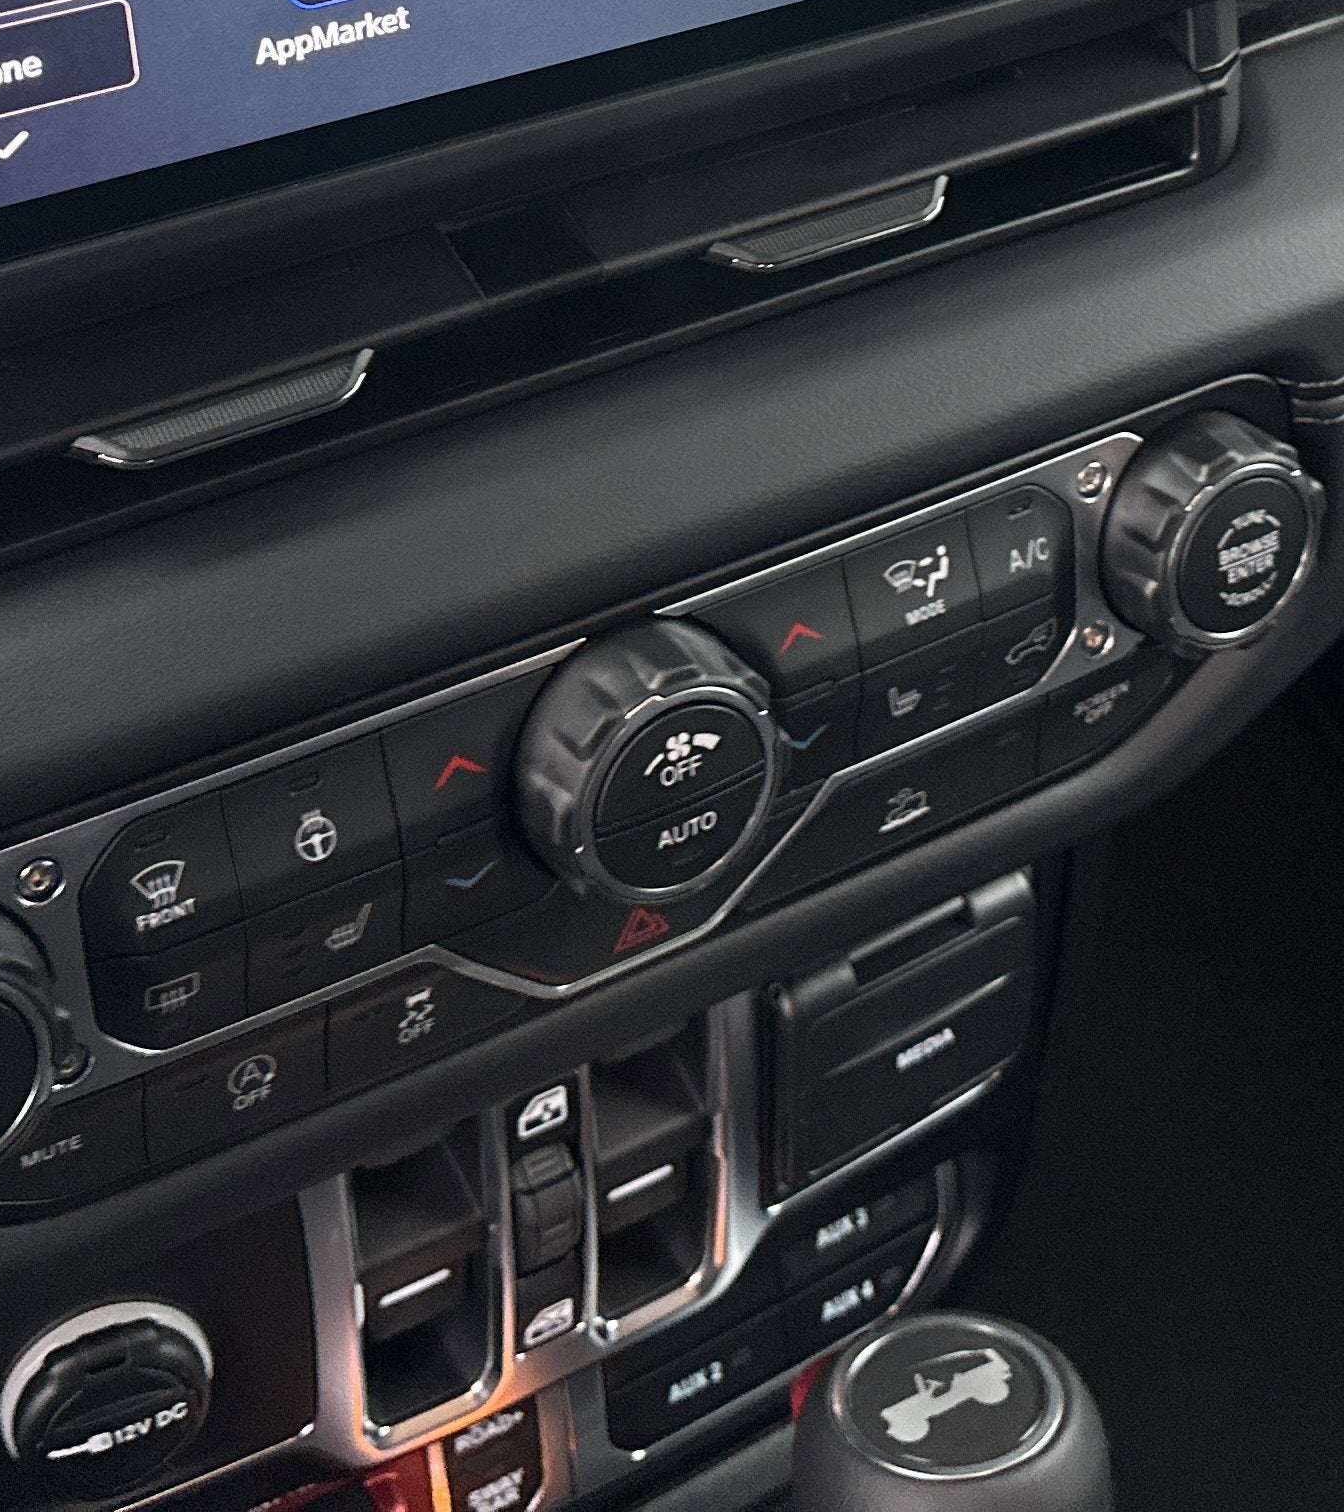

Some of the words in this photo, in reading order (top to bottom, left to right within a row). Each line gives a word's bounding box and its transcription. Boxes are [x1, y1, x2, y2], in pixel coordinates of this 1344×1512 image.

[255, 7, 411, 67] AppMarket
[1009, 536, 1050, 573] A/C
[1218, 529, 1280, 566] BROWSE
[1227, 552, 1276, 585] ENTER
[905, 598, 947, 626] MODE
[659, 754, 703, 788] OFF
[658, 810, 718, 850] AUTO
[135, 898, 196, 932] FRONT
[398, 1017, 436, 1044] OFF
[232, 1084, 272, 1112] OFF
[20, 1134, 83, 1169] MUTE
[816, 1215, 854, 1249] AUX
[821, 1285, 861, 1322] AUX
[668, 1368, 708, 1405] AUX
[114, 1417, 154, 1444] 12V
[155, 1401, 189, 1428] DC
